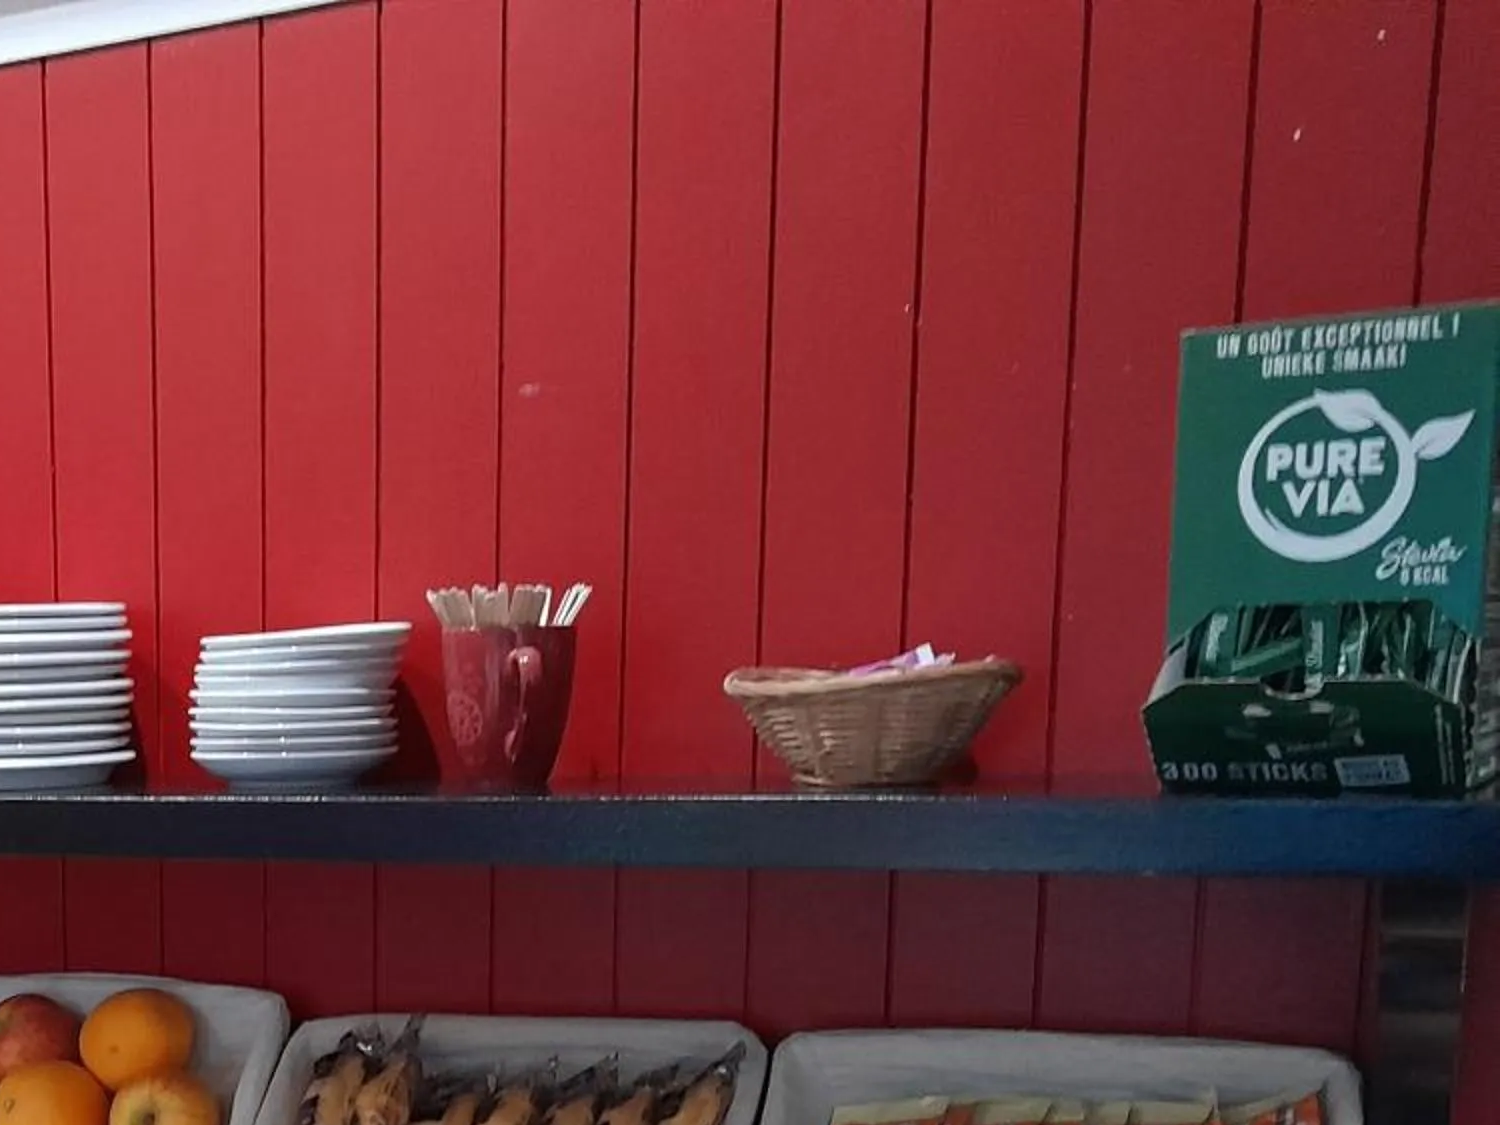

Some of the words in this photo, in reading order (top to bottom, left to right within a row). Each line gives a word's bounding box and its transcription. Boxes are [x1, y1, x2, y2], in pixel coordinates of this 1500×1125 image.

[1217, 334, 1241, 359] UN
[1247, 325, 1295, 356] GOÛT
[1301, 313, 1443, 350] EXCEPTIONNEL
[1262, 351, 1326, 379] UNIEKE
[1265, 436, 1388, 483] PURE
[1282, 479, 1366, 518] VIA
[1161, 762, 1218, 782] 300
[1226, 761, 1328, 783] STICKS
